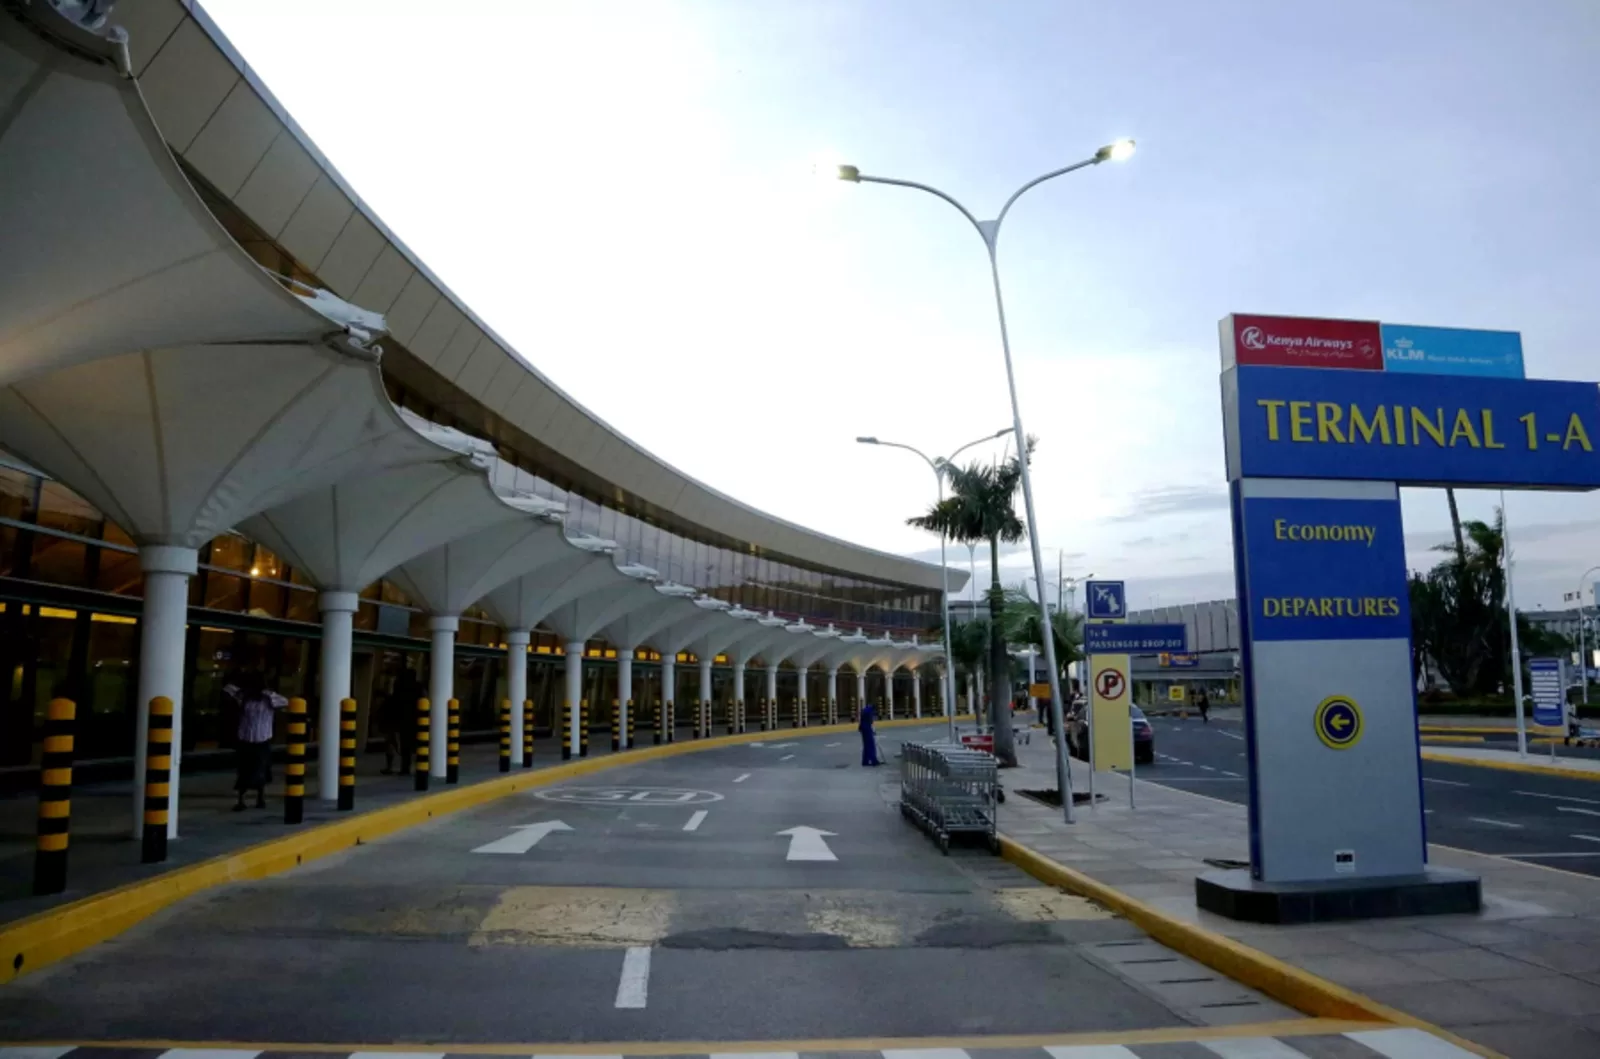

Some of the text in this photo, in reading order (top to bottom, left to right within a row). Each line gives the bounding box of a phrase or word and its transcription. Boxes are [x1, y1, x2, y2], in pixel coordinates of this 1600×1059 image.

[1267, 334, 1303, 347] Kenya
[1304, 336, 1353, 351] Airways
[1386, 348, 1425, 361] KLM
[1257, 398, 1593, 452] TERMINAL 1-A
[1274, 518, 1376, 547] Economy
[1262, 597, 1400, 618] DEPARTURES
[1089, 639, 1139, 649] PASSENGER
